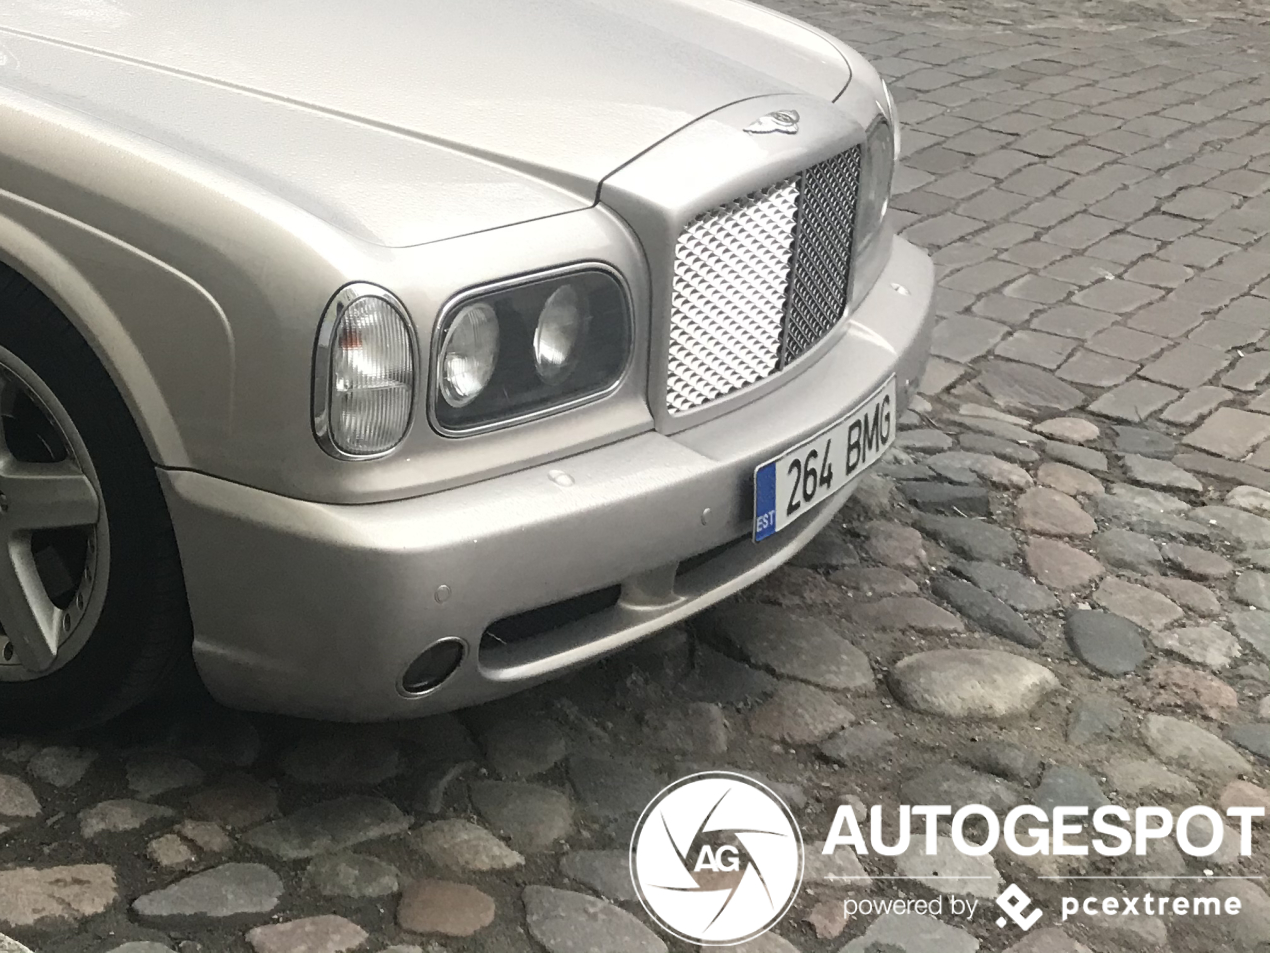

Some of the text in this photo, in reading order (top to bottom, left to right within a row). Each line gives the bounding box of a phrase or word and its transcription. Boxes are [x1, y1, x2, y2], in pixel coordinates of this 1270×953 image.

[786, 394, 890, 516] 264 BMG
[757, 510, 775, 532] EST
